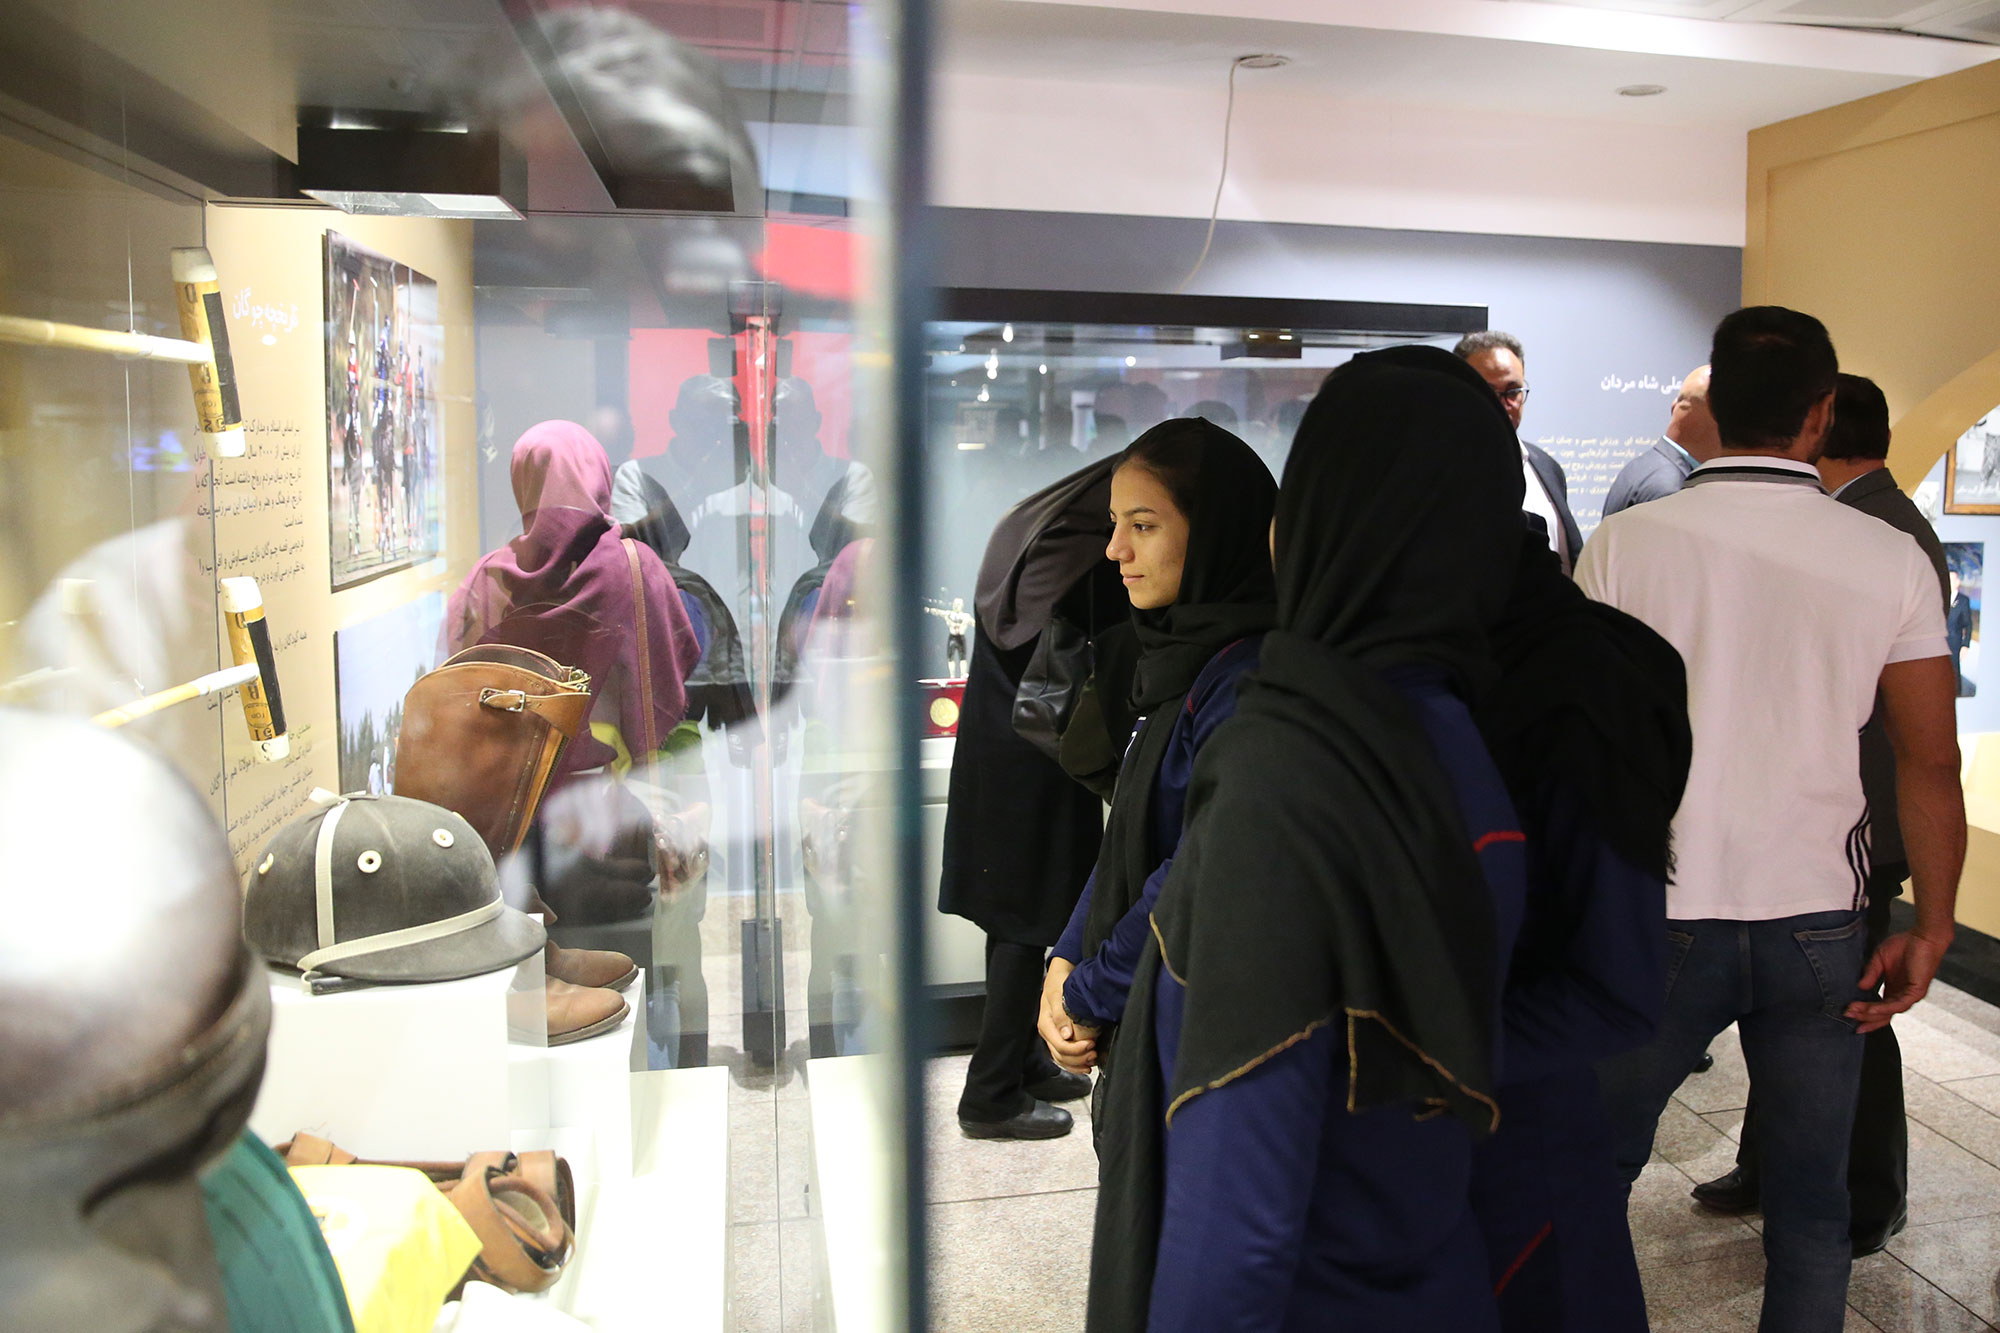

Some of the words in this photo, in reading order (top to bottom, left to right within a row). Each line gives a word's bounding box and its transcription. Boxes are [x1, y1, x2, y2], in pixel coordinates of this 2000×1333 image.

[232, 286, 264, 328] چوگان
[1600, 373, 1636, 394] مردان
[1638, 374, 1659, 390] شاه
[254, 727, 273, 741] 51
